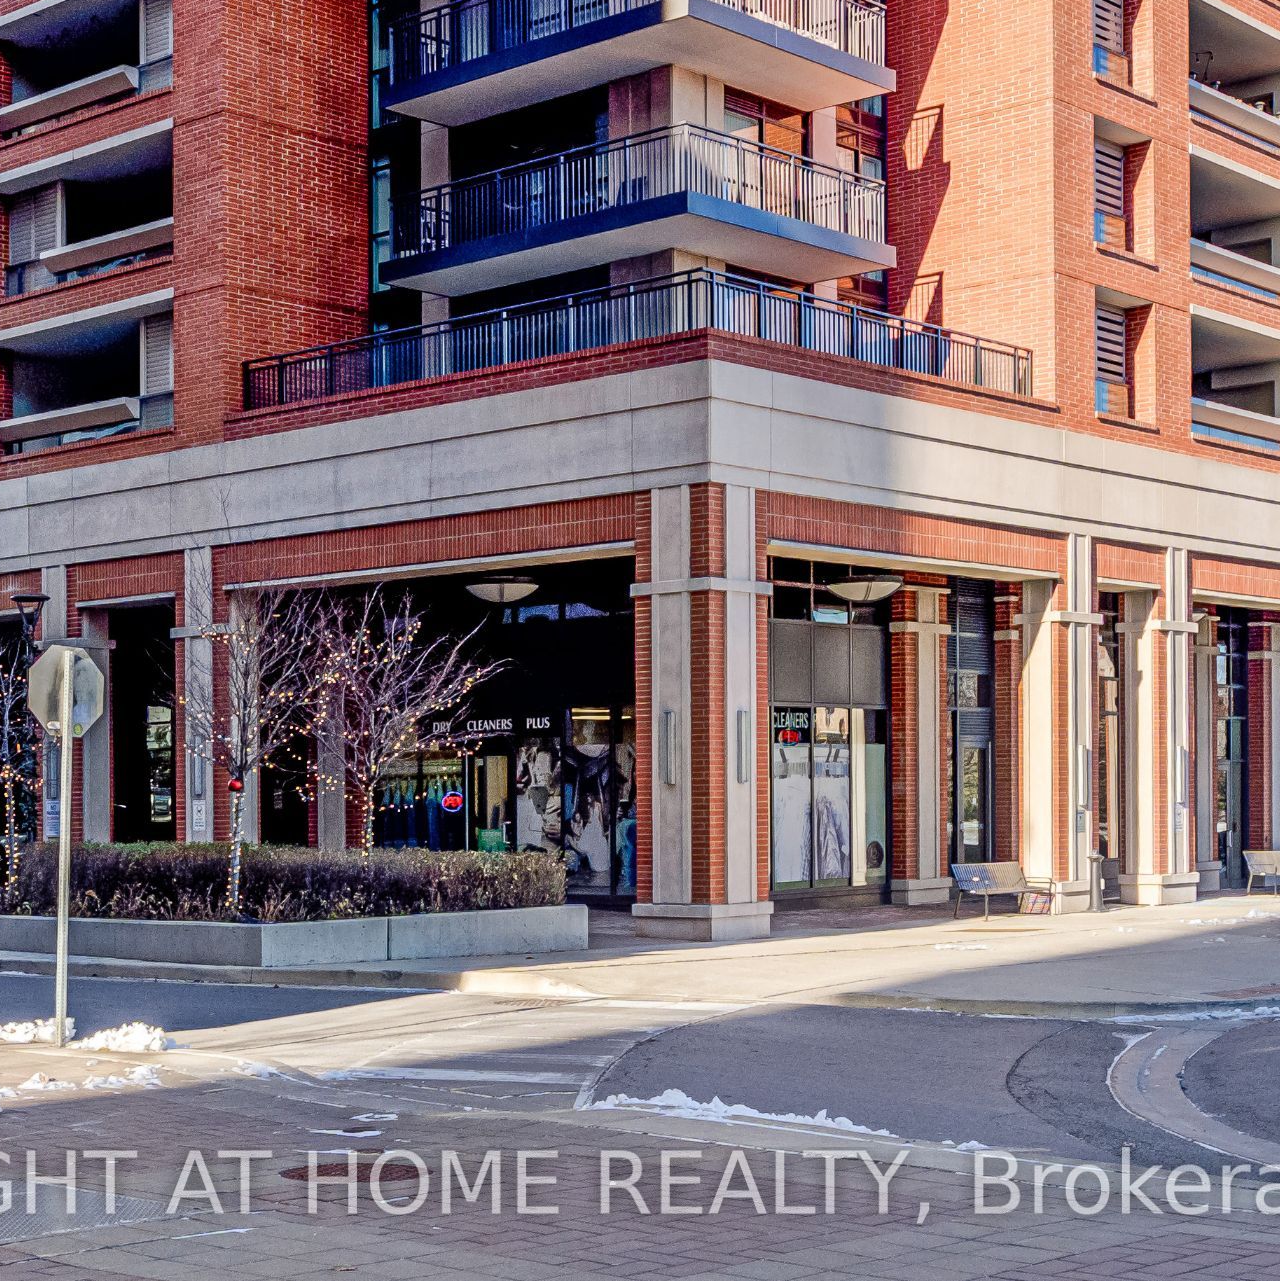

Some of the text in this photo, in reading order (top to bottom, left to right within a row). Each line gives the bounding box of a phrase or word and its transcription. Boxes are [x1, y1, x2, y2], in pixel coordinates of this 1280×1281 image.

[433, 717, 551, 733] DRY CLEANERS PLUS
[773, 711, 809, 729] CLEANERS
